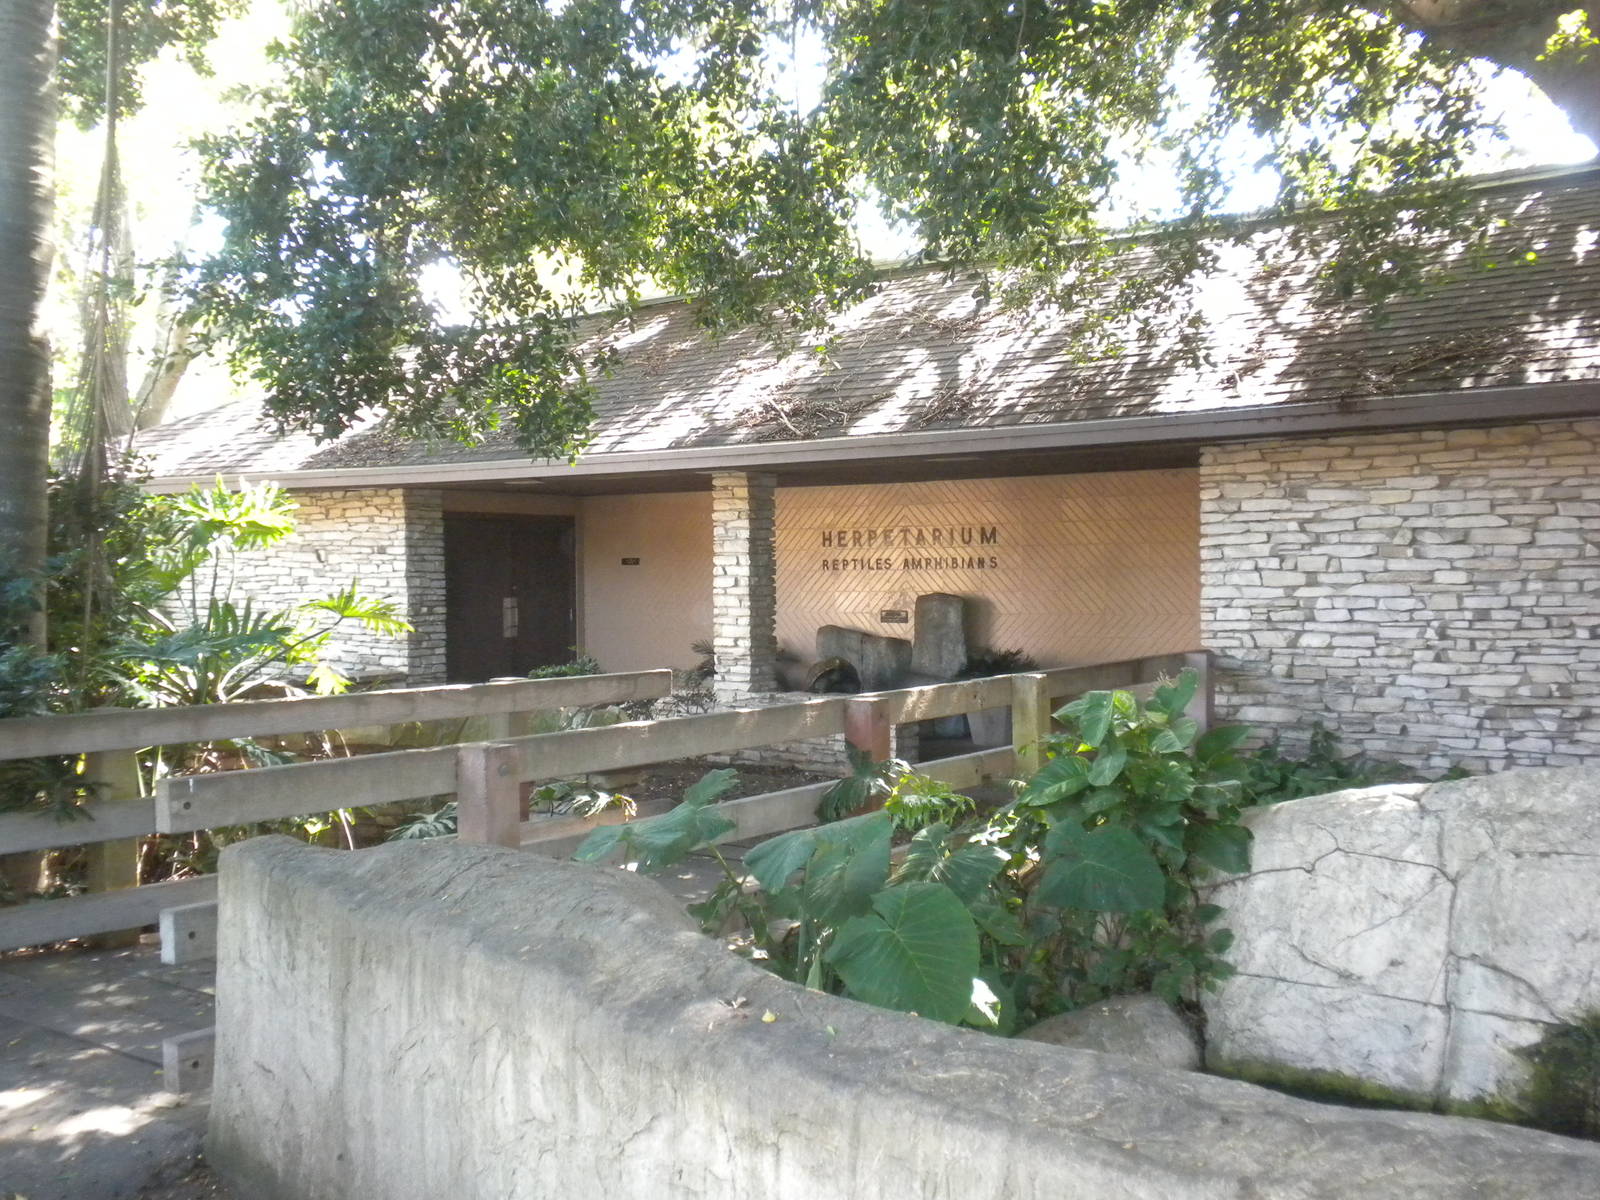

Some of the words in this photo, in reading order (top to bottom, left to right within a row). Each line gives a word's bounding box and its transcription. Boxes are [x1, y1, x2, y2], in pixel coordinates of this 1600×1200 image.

[822, 526, 998, 547] HERPETARIUM
[822, 558, 892, 571] REPTILES
[903, 556, 998, 570] AMPHIBIANS
